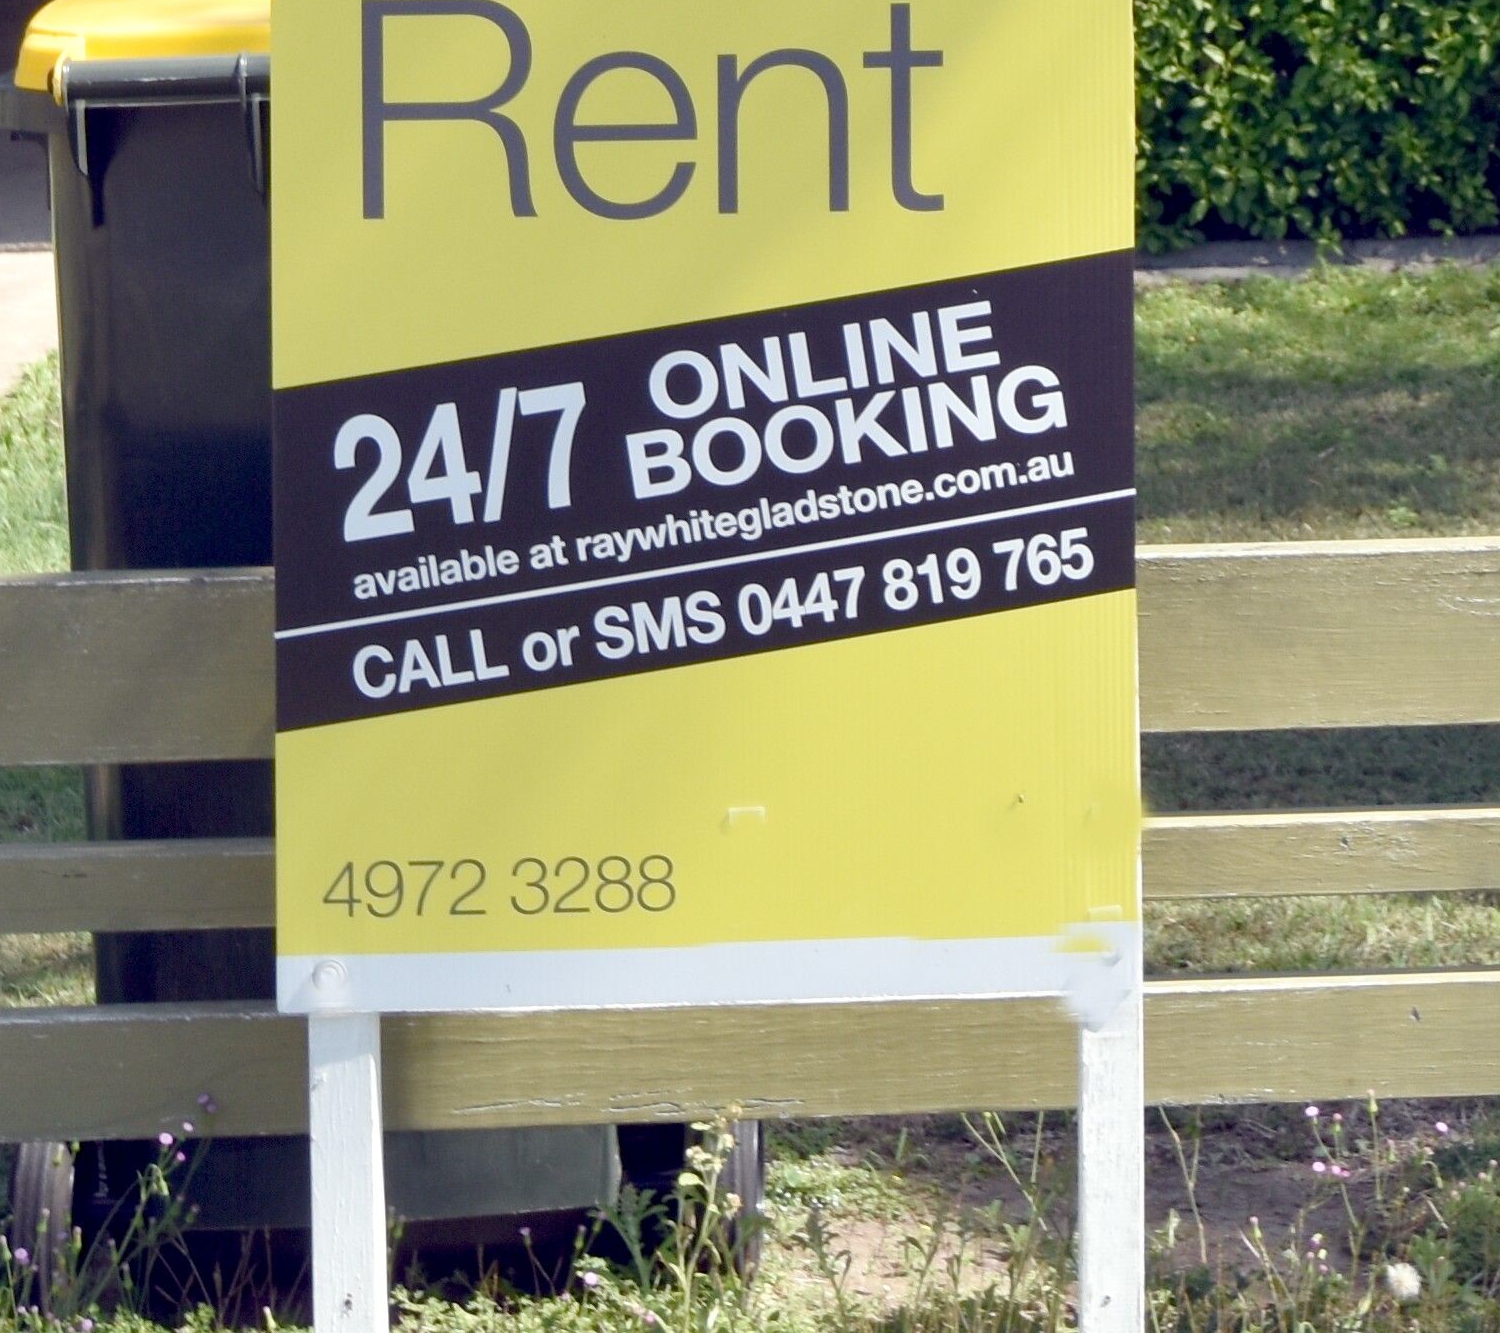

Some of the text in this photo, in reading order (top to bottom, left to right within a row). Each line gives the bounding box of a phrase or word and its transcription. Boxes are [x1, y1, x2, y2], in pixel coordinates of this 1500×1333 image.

[648, 300, 1001, 420] ONLINE
[333, 381, 586, 543] 24/7
[625, 364, 1068, 501] BOOKING
[353, 451, 1075, 600] available at raywhitegladstone.com.au
[352, 526, 1095, 699] CALL or SMS 0447 819 765
[322, 854, 676, 919] 4972 3288
